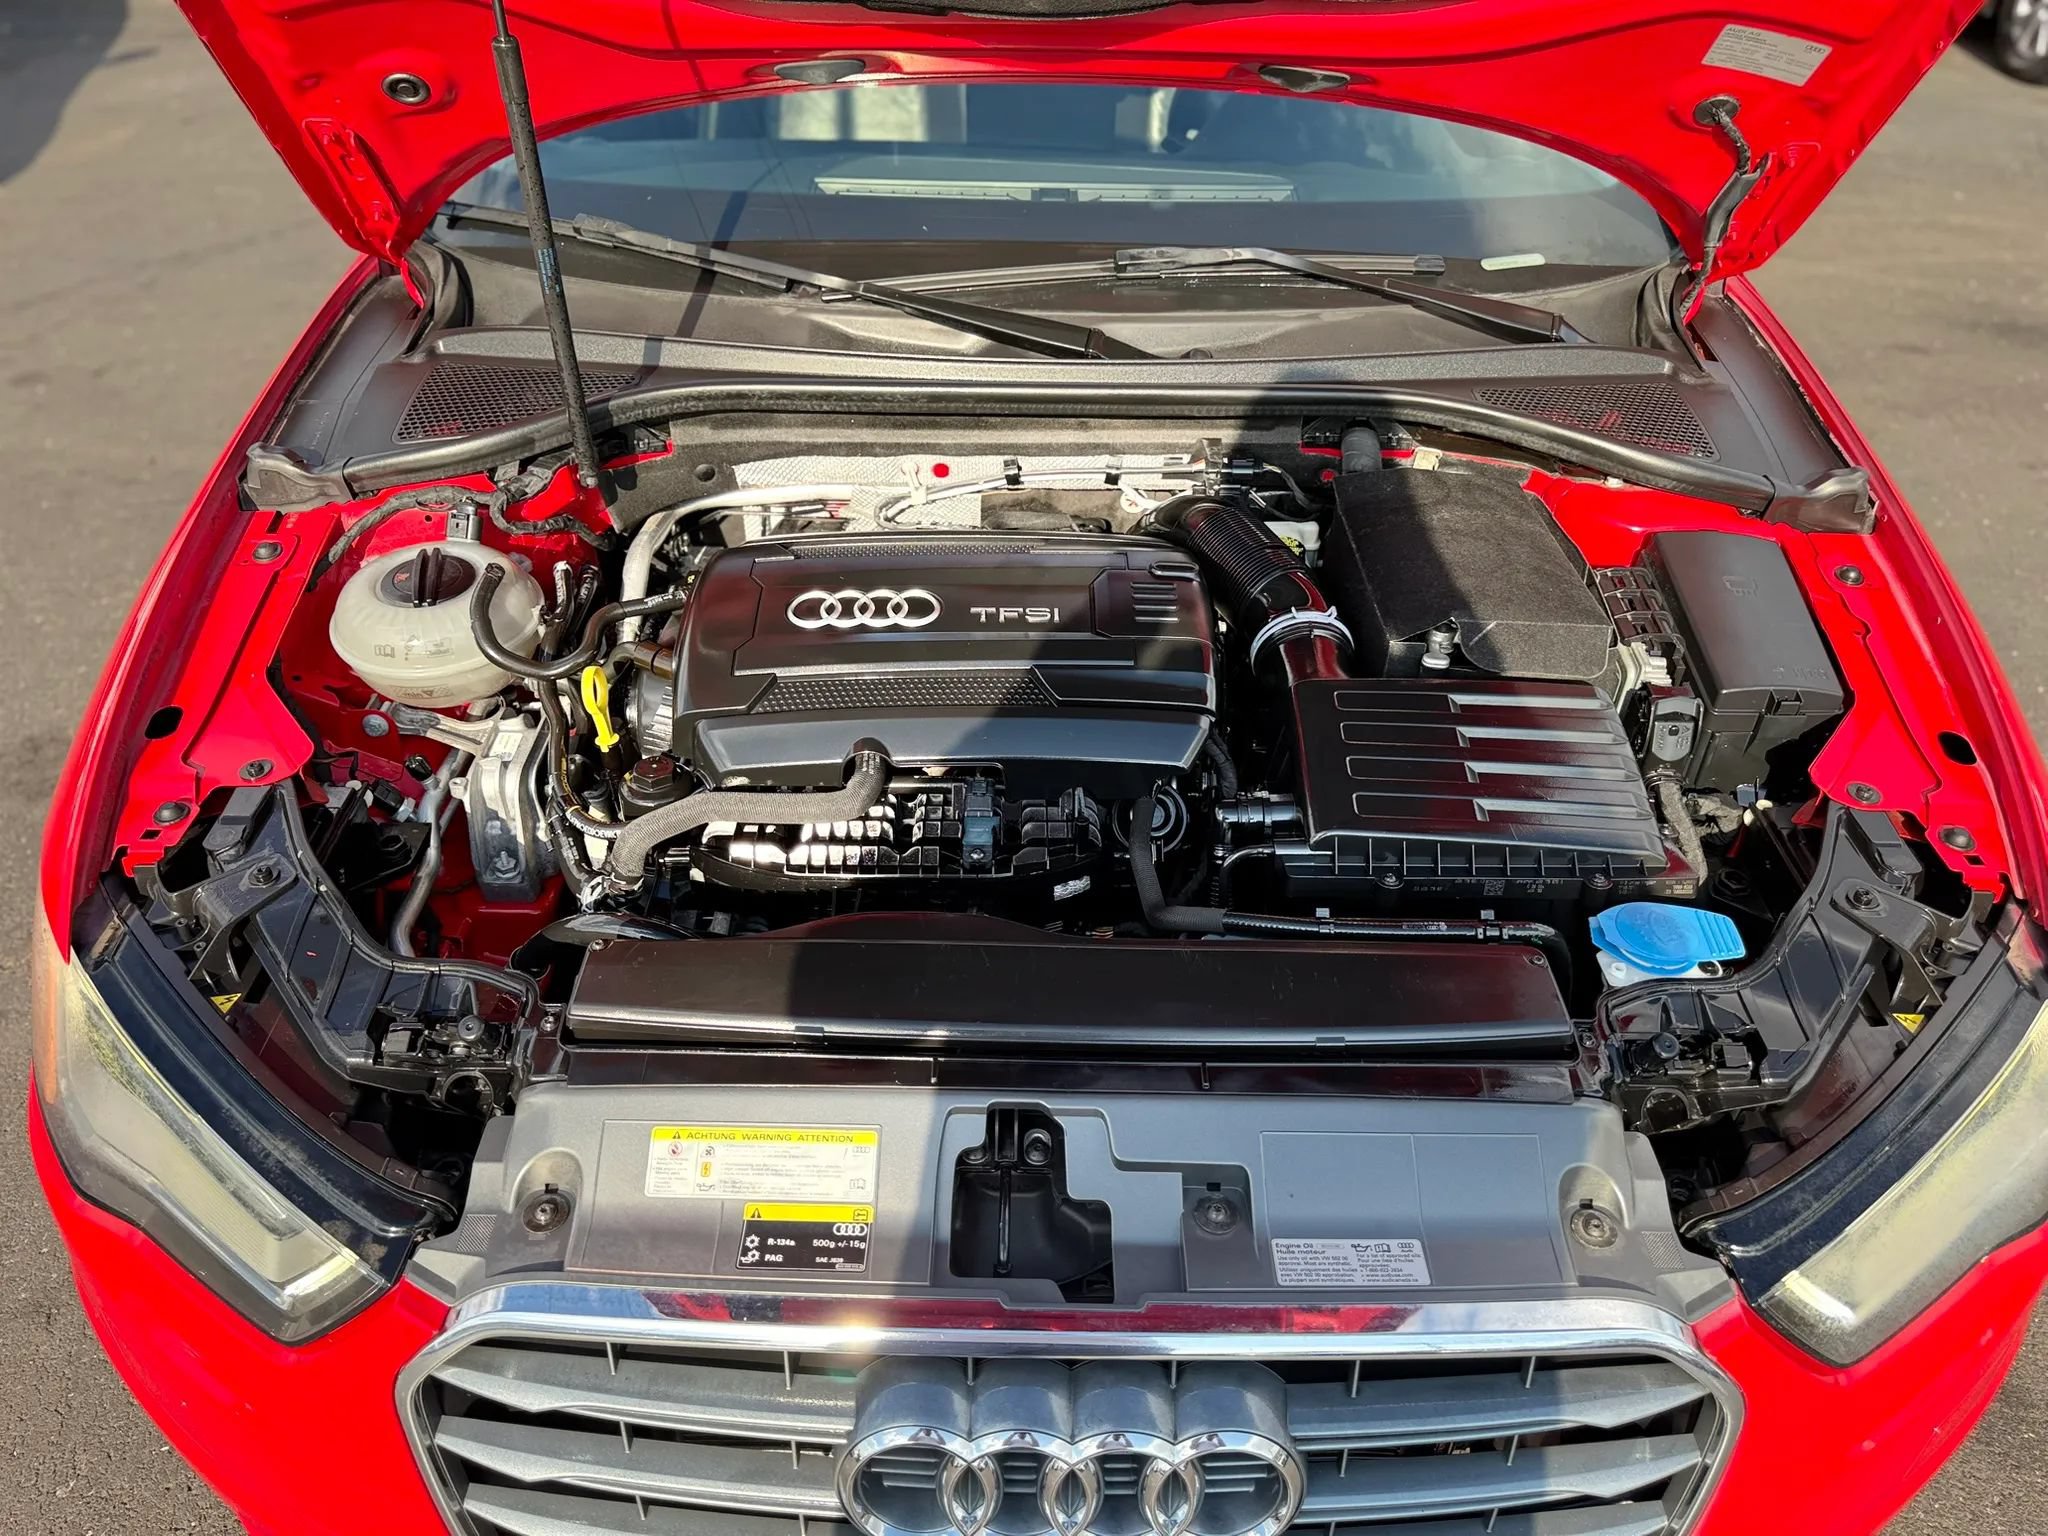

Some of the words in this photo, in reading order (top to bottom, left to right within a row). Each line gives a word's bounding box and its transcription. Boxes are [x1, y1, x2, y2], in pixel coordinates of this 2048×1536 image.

[969, 607, 1060, 624] TFSI
[686, 1131, 736, 1140] ACHTUNG
[741, 1133, 792, 1141] WARNING
[797, 1134, 854, 1142] ATTENTION
[767, 1238, 796, 1246] R-134a
[812, 1238, 836, 1249] 500g
[1275, 1242, 1301, 1250] Engine
[764, 1254, 783, 1262] PAG
